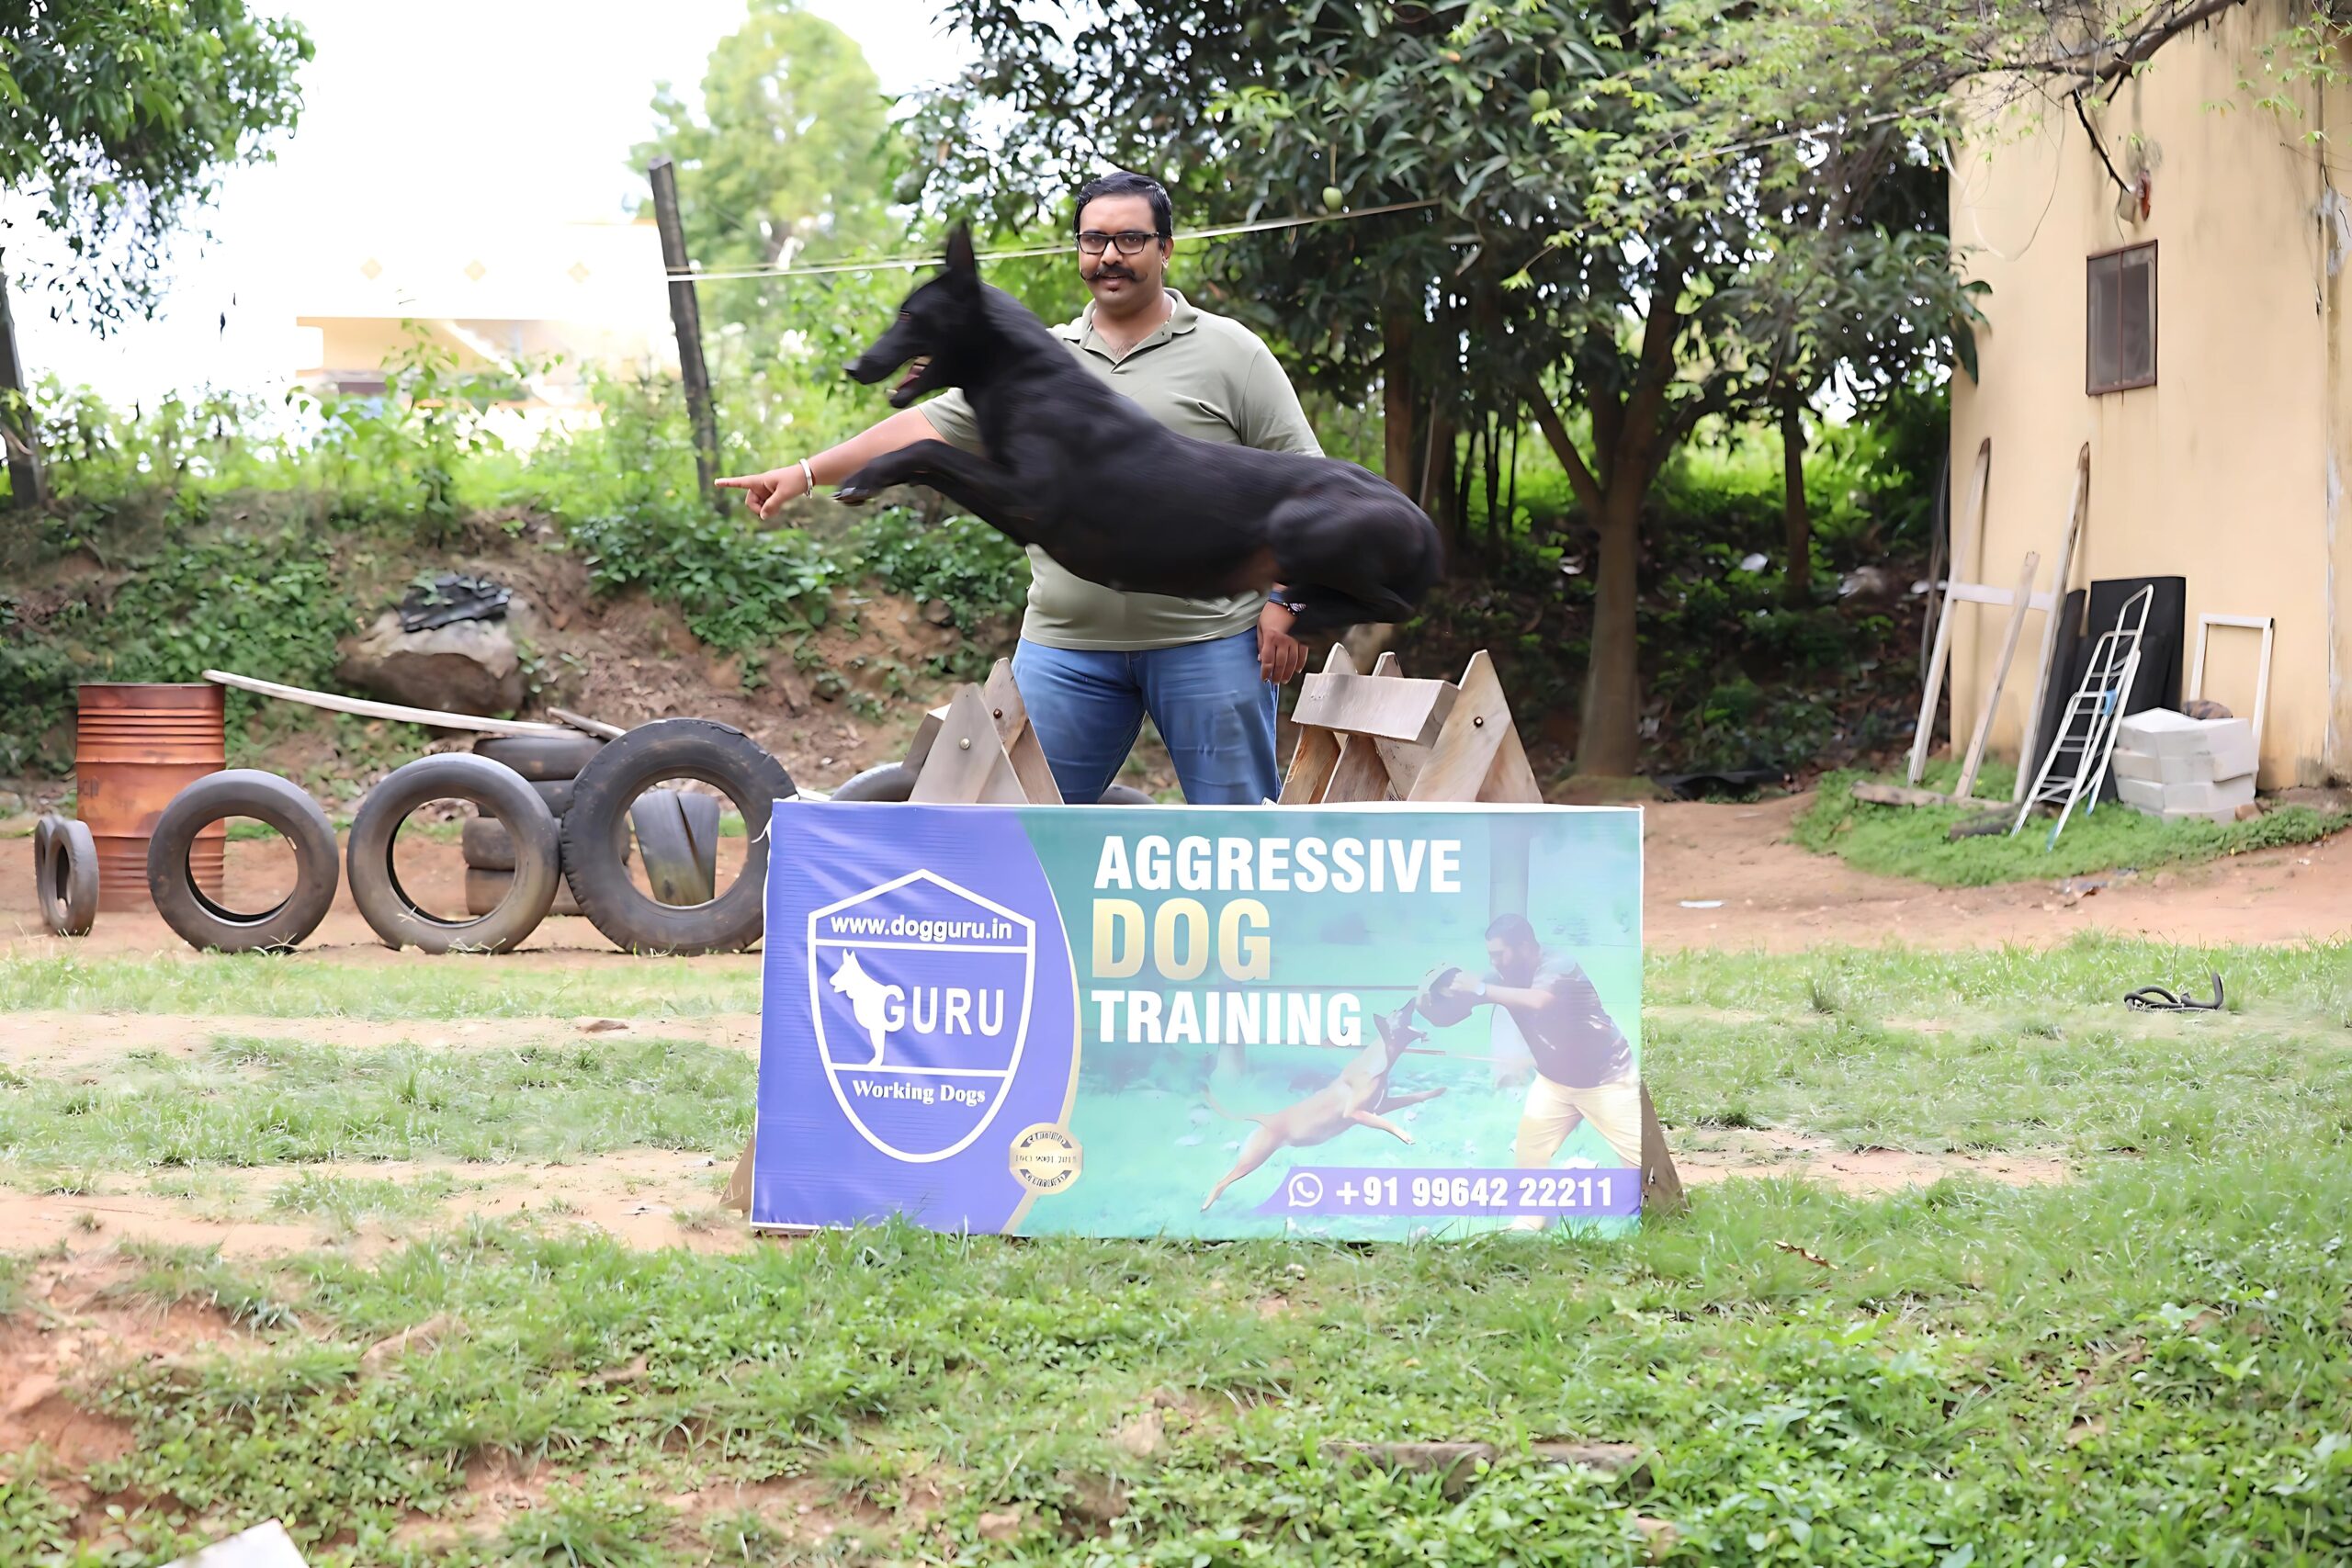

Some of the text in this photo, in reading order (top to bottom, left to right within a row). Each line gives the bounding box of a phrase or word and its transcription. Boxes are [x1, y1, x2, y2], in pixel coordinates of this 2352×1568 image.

[1093, 835, 1461, 893] AGGRESSIVE
[831, 914, 1012, 943] www.dogguru.in
[1092, 898, 1271, 981] DOG
[882, 984, 1005, 1037] GURU
[1091, 990, 1362, 1047] TRAINING
[852, 1079, 986, 1107] Working Dogs
[1336, 1176, 1612, 1208] +91 99642 22211
